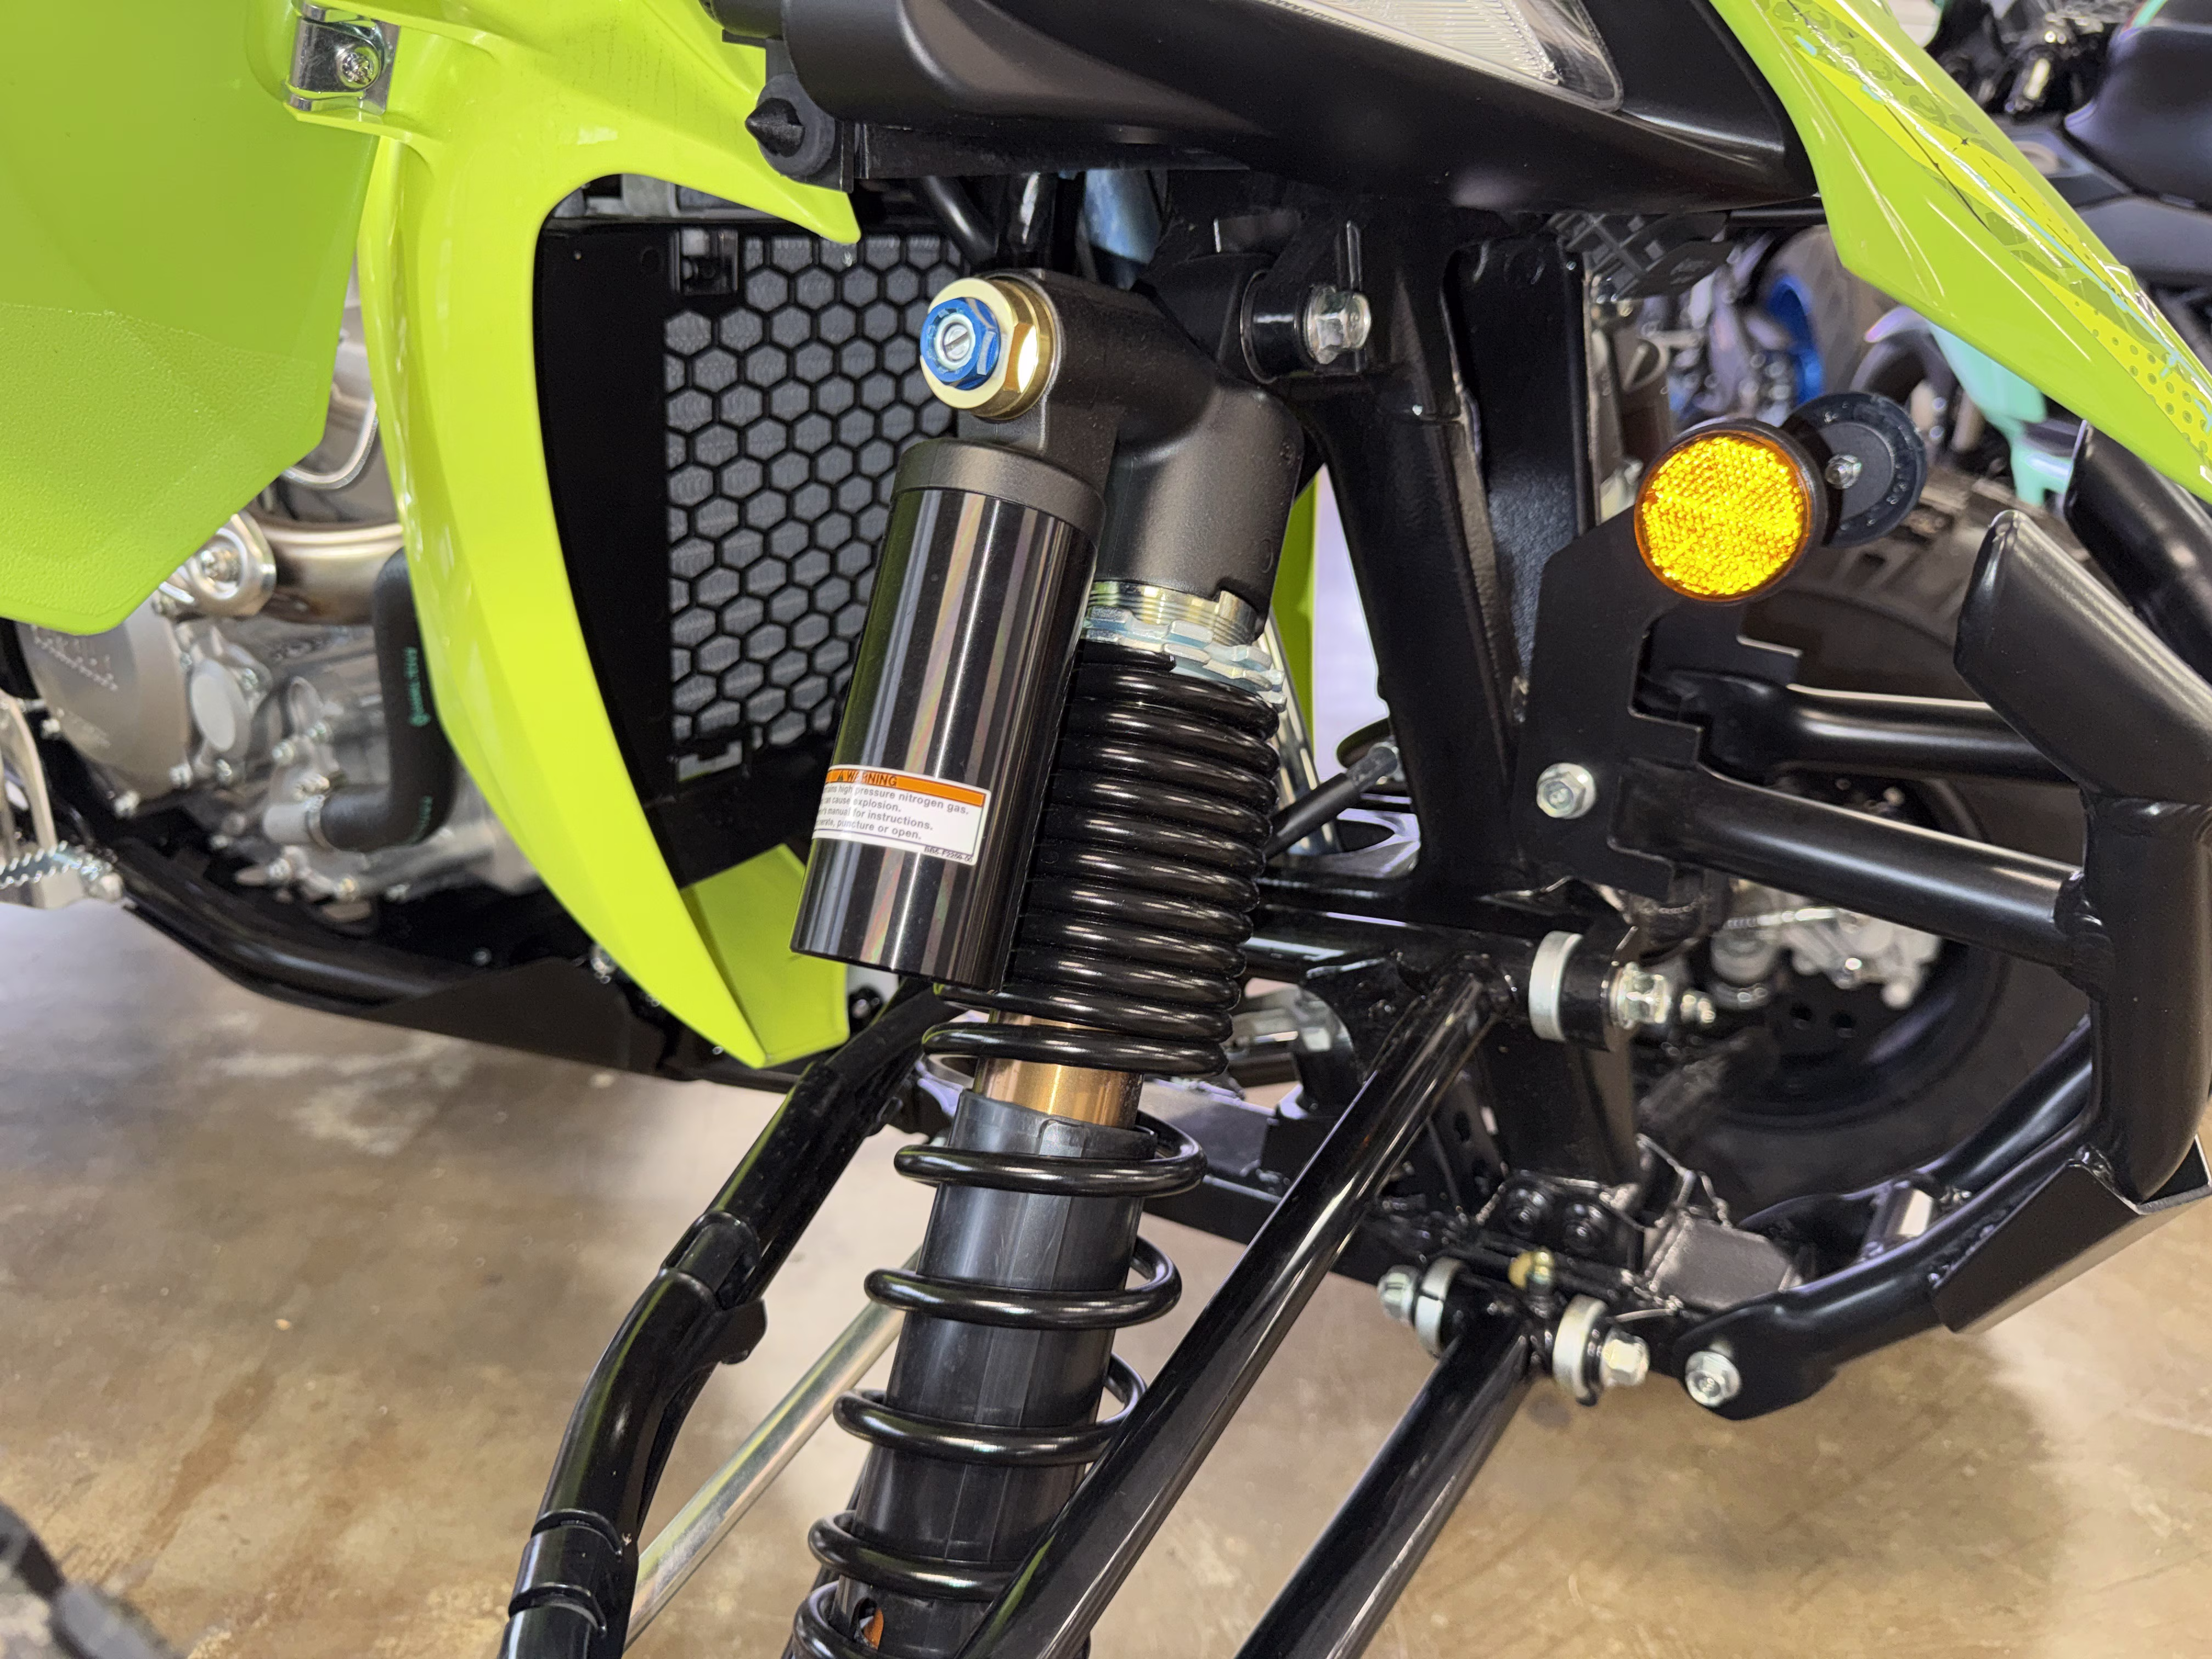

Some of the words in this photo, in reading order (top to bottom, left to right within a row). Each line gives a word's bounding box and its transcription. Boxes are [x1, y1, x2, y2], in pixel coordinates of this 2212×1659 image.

[832, 797, 851, 805] cause
[853, 798, 901, 812] explosion.
[838, 785, 853, 795] high
[854, 787, 895, 799] pressure
[898, 792, 944, 809] nitrogen
[947, 803, 969, 815] gas.
[827, 806, 851, 816] manual
[853, 807, 865, 818] for
[867, 810, 934, 831] instructions.
[837, 819, 874, 831] puncture
[877, 825, 889, 833] or
[891, 827, 922, 840] open.
